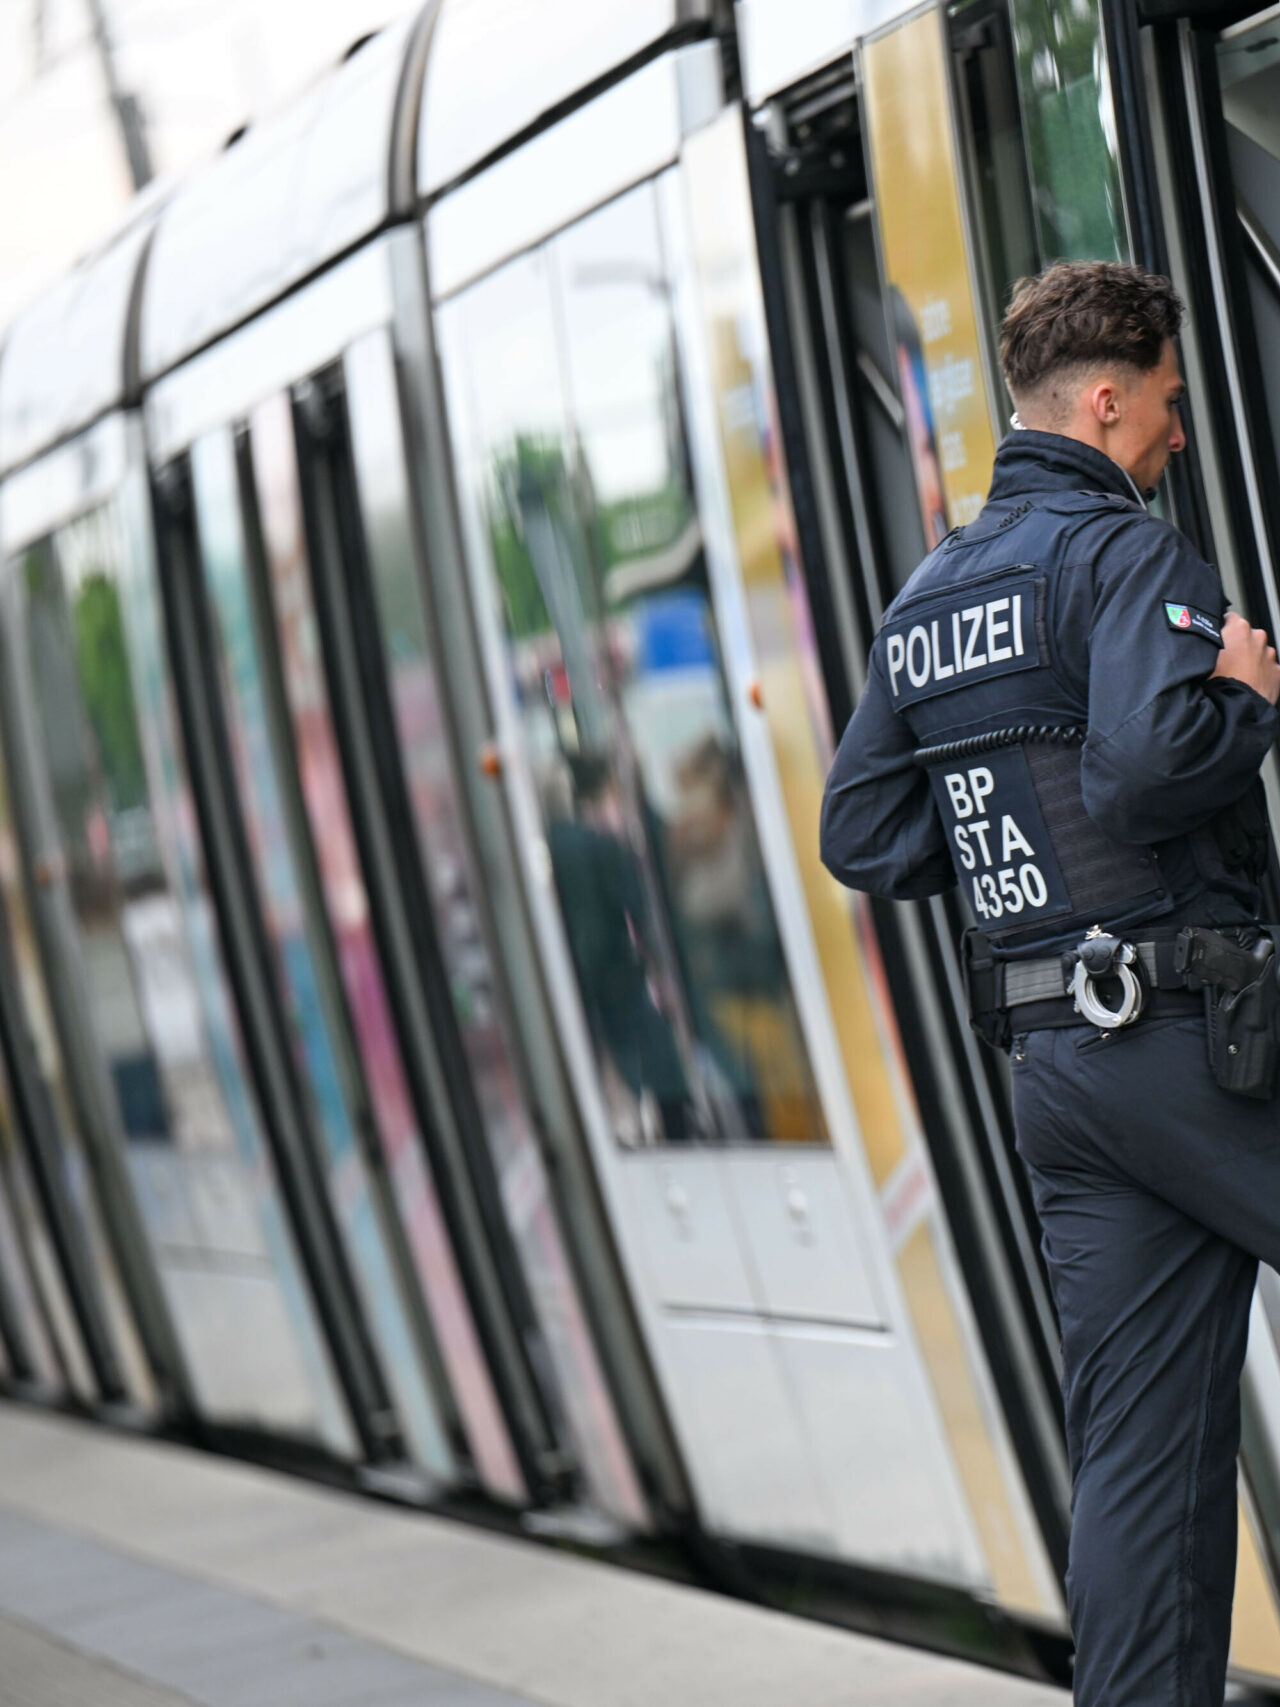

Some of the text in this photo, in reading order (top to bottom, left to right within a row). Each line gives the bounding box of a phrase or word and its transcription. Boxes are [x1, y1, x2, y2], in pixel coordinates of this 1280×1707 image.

[886, 594, 1025, 697] POLIZEI
[944, 767, 994, 819] BP
[972, 863, 1048, 919] 4350
